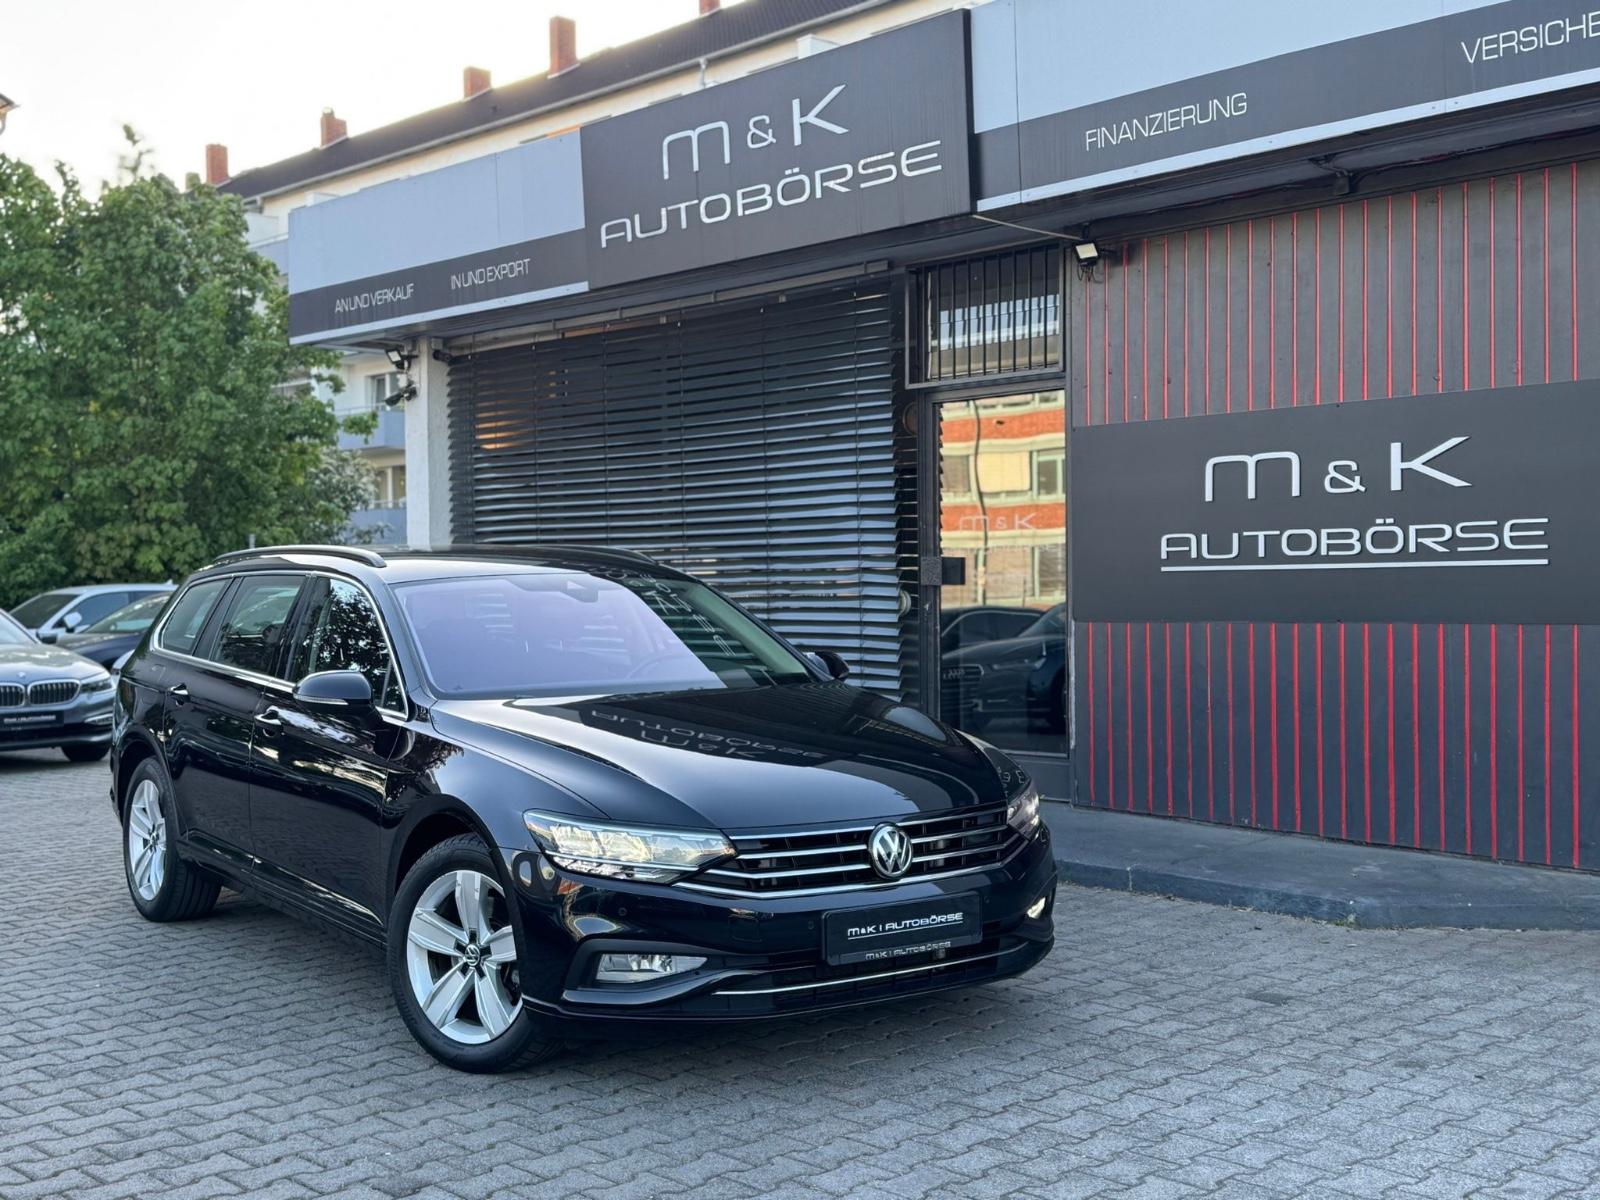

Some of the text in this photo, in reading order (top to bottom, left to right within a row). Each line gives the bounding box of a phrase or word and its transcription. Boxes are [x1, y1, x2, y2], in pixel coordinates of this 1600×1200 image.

[1461, 10, 1600, 64] VERSICHE
[662, 84, 849, 180] M & K
[1085, 92, 1248, 152] FINANZIERUNG
[600, 139, 942, 249] AUTOBÖRSE
[450, 258, 531, 290] IN UND EXPORT
[334, 283, 414, 314] AN UND VERKAUF
[1204, 436, 1473, 502] M & K
[1014, 511, 1041, 532] K
[1160, 517, 1549, 560] AUTOBÖRSE
[885, 912, 964, 931] AUTOBÖRSE
